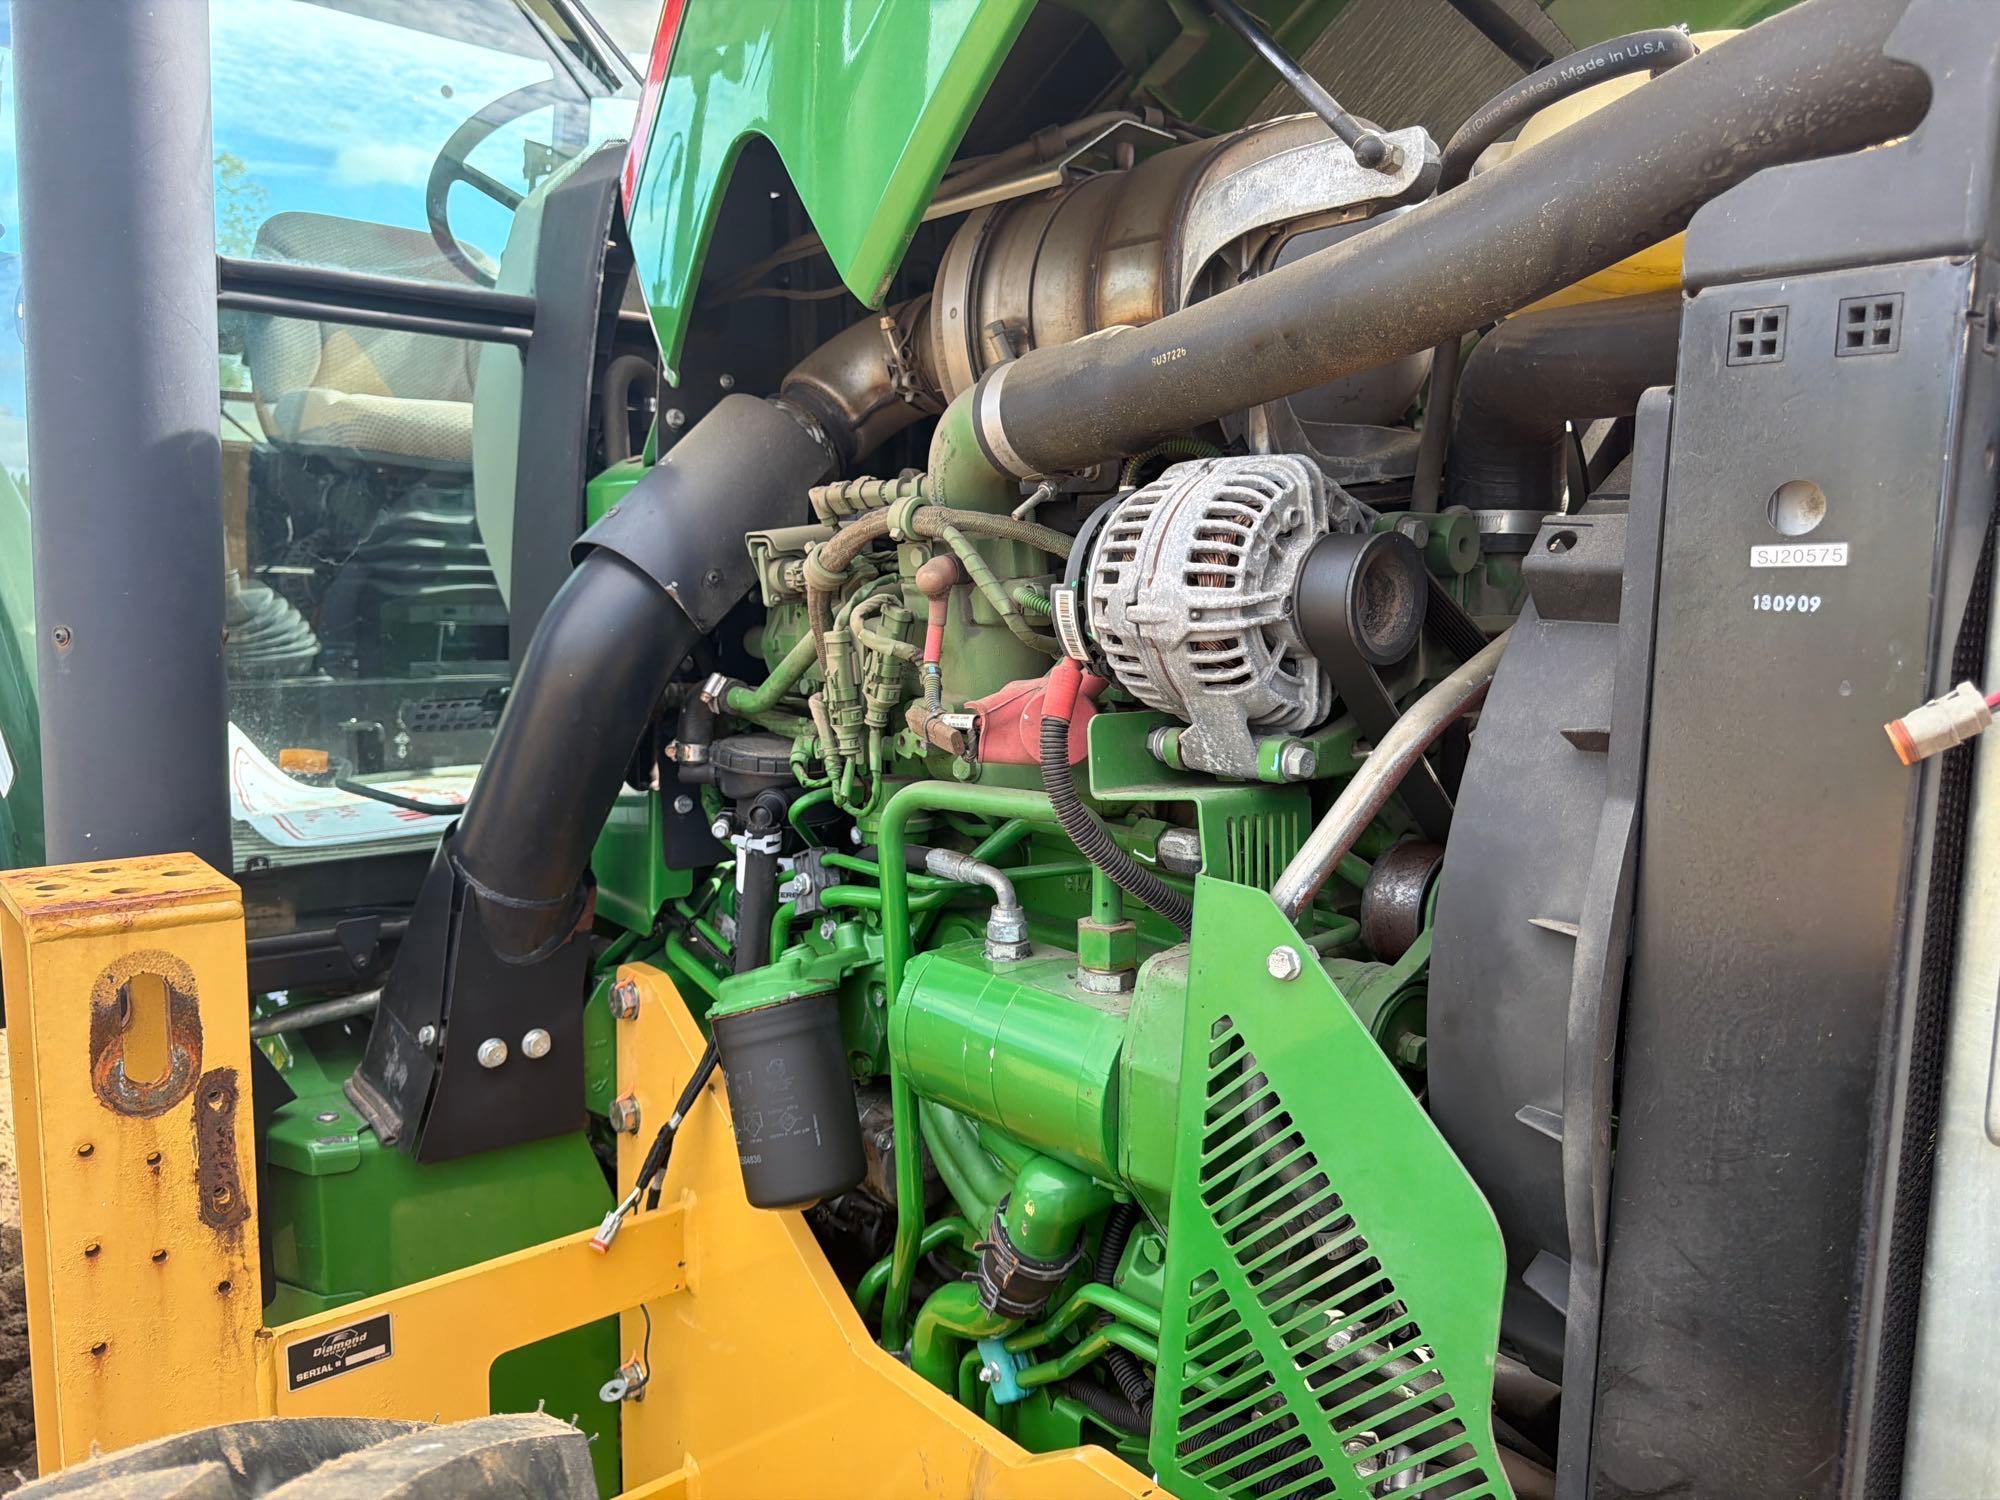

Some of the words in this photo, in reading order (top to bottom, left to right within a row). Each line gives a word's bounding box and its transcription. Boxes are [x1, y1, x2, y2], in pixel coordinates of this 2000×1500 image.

[1559, 57, 1606, 82] Made
[1608, 50, 1625, 64] In
[1756, 547, 1844, 566] SJ20575
[1752, 593, 1822, 613] 180909
[312, 1331, 368, 1358] Diamond
[295, 1362, 334, 1383] SERIAL
